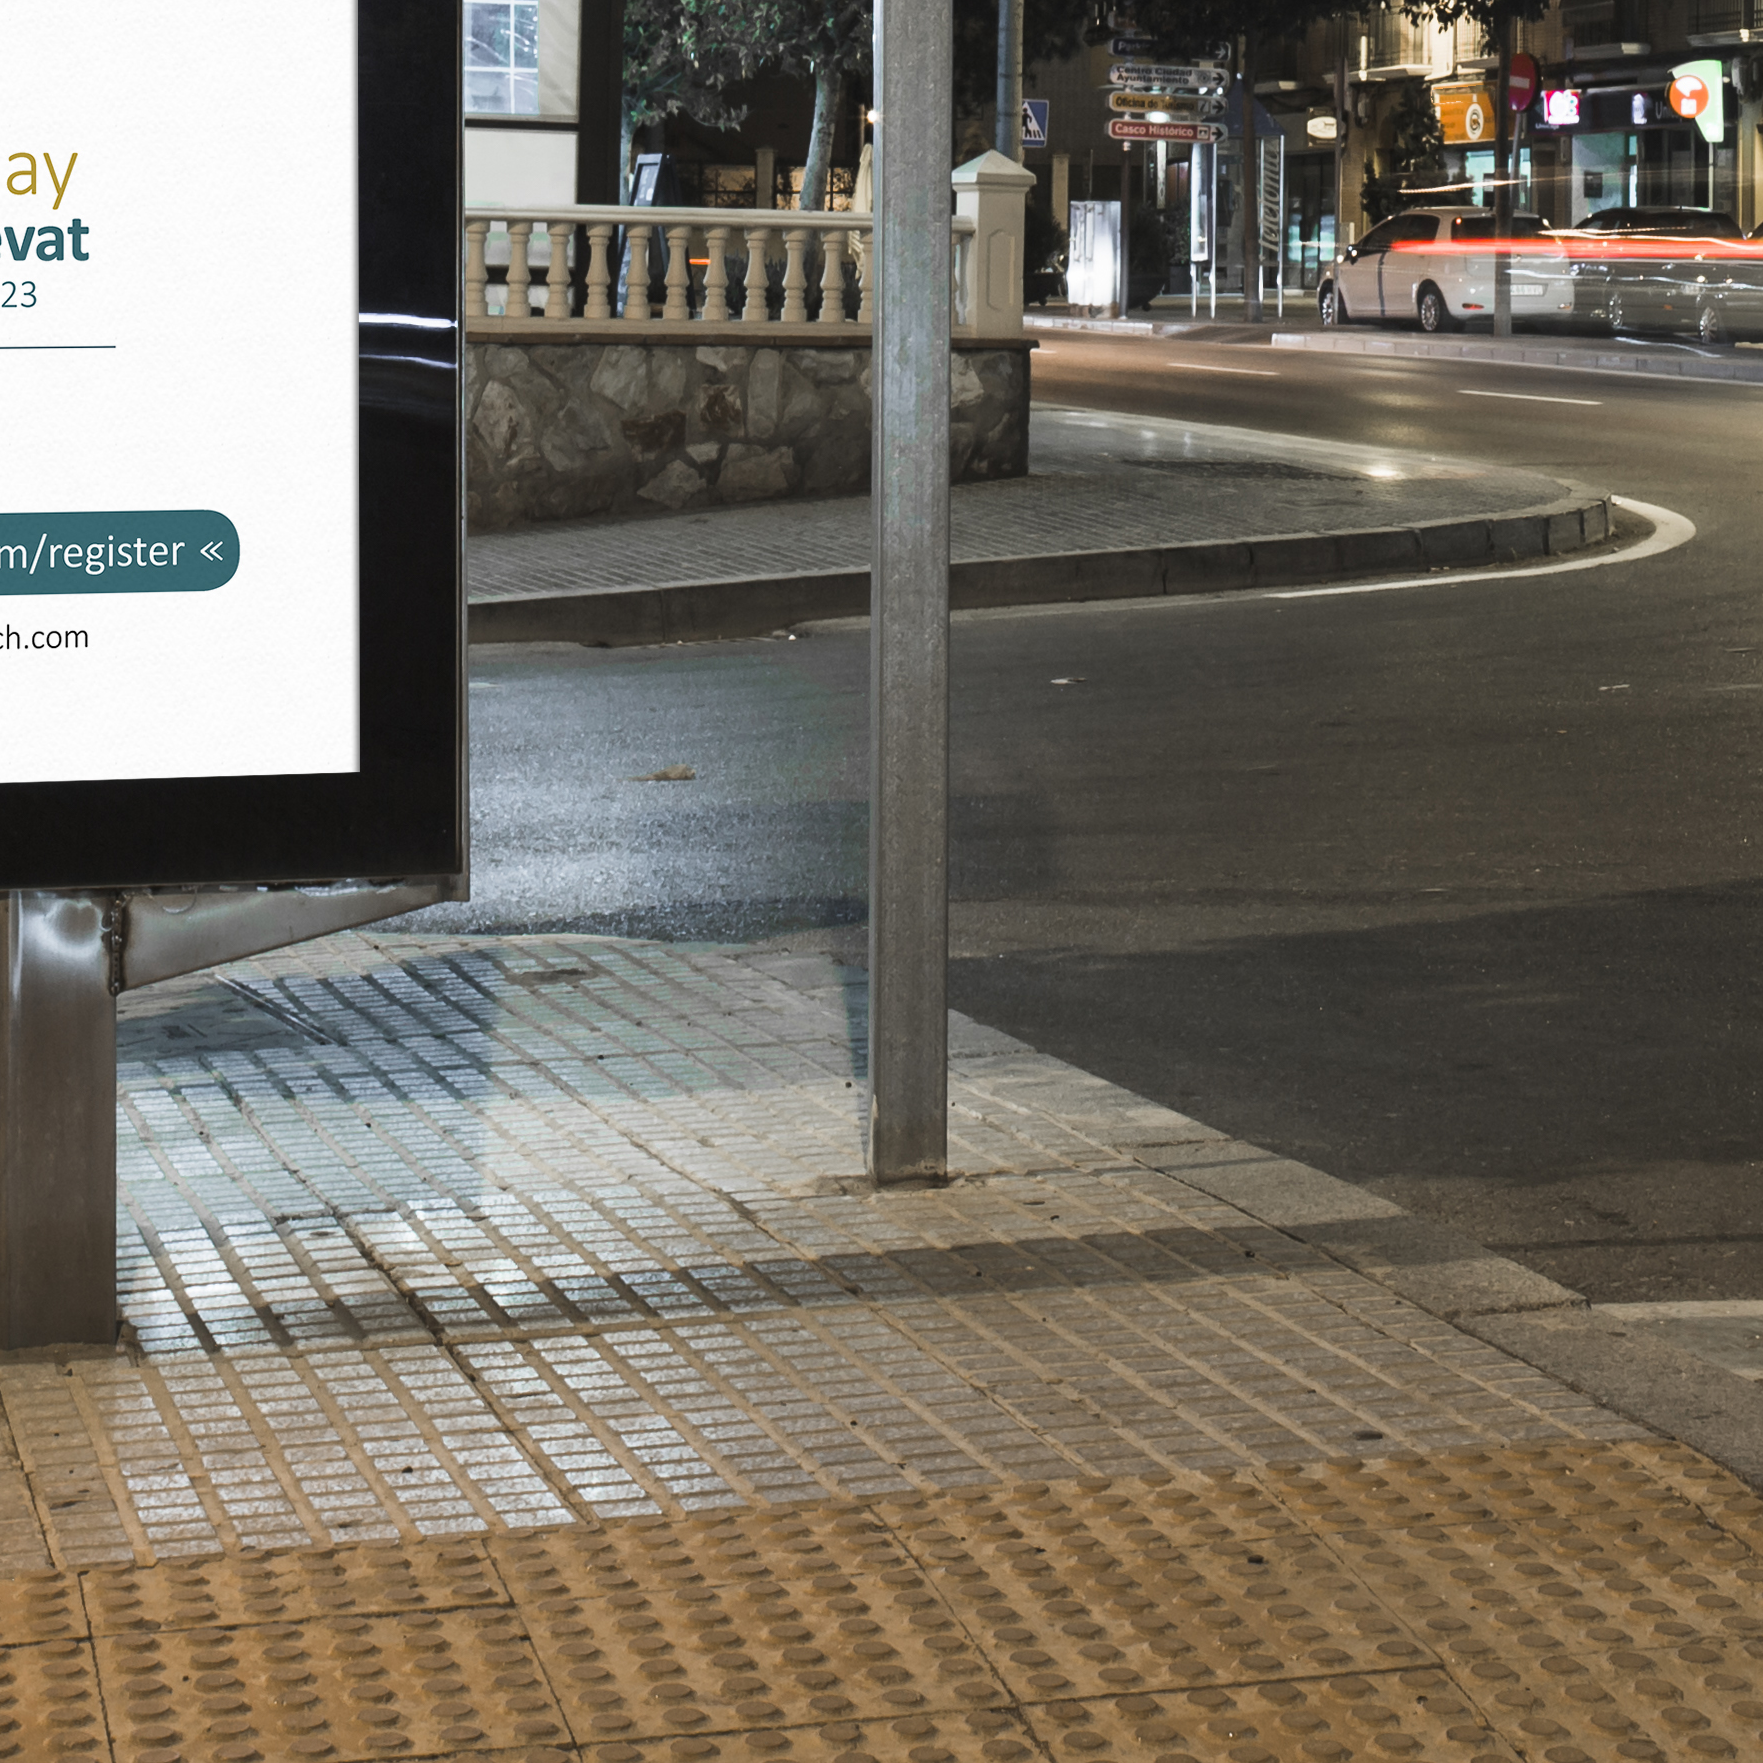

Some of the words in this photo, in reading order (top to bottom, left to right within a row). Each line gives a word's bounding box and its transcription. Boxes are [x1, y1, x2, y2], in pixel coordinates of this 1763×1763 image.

[1117, 66, 1151, 75] Centro
[1155, 68, 1192, 77] Ciudad
[1117, 73, 1189, 85] Ayuntamiento
[1116, 97, 1145, 108] Oficina
[1148, 99, 1158, 108] de
[1115, 123, 1145, 135] Casco
[1149, 125, 1193, 137] Histórico
[2, 281, 36, 308] 23
